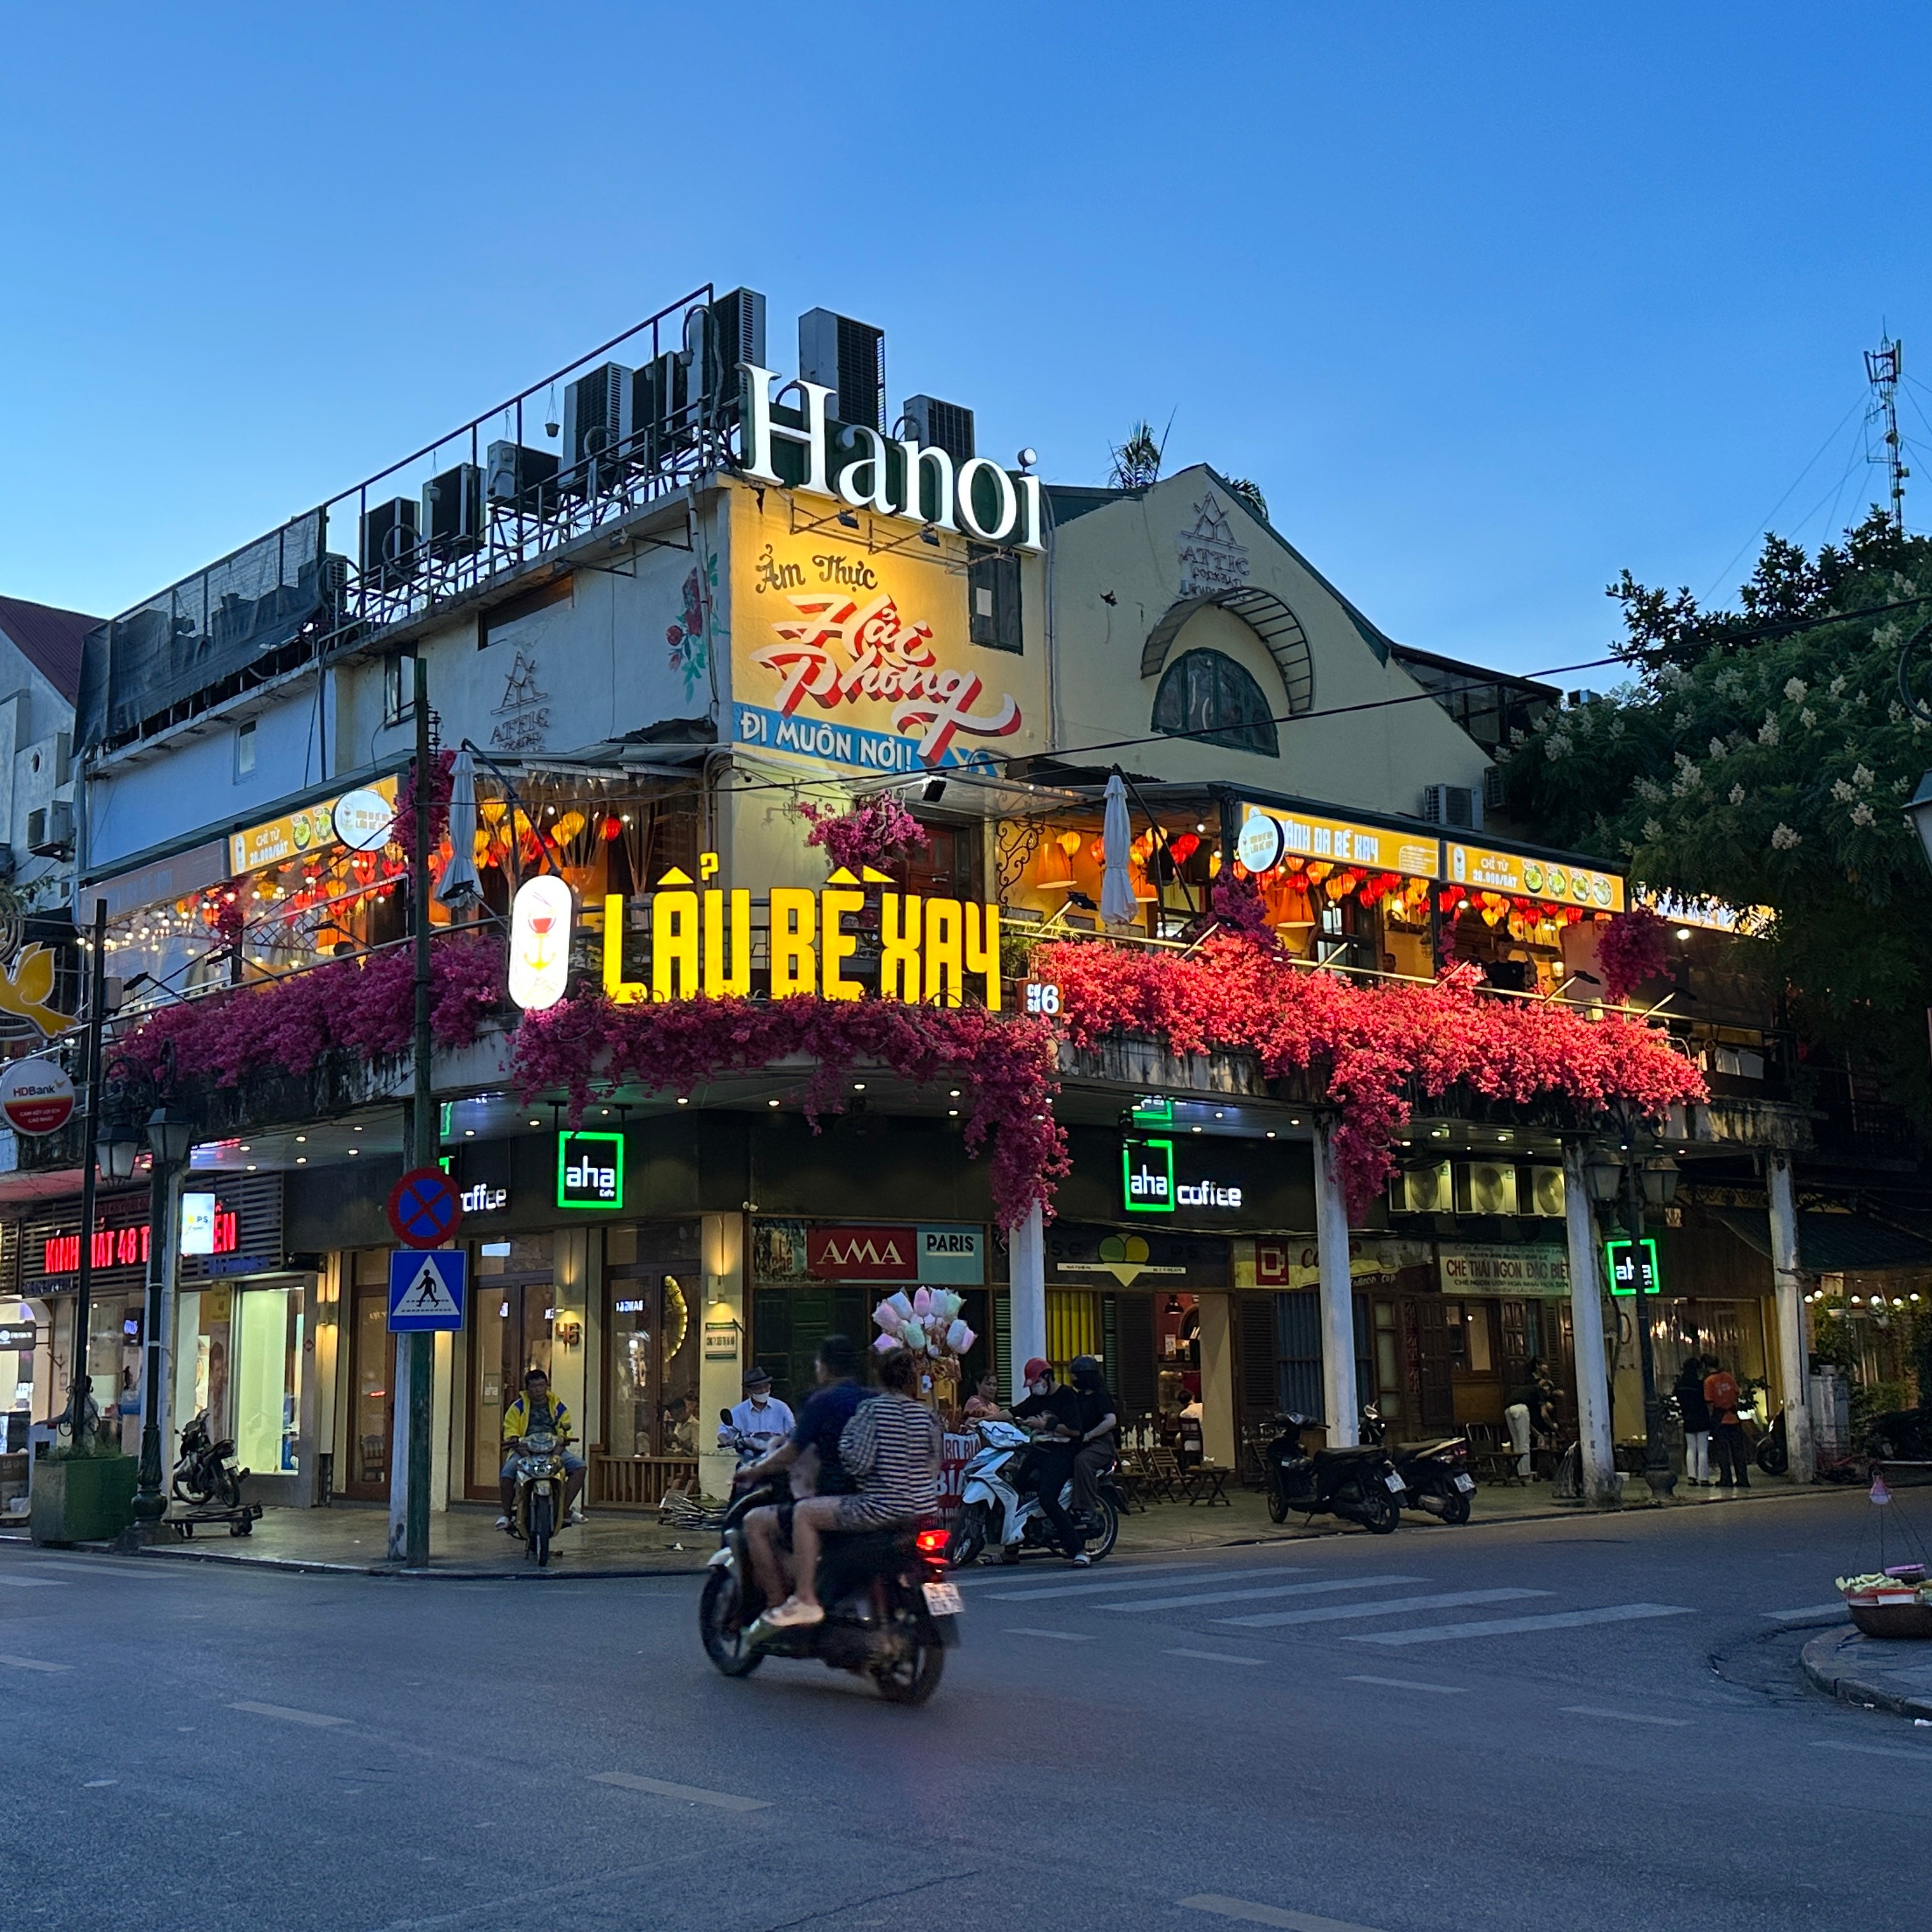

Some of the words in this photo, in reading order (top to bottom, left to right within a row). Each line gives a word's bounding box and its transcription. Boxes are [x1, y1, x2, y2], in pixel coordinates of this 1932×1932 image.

[734, 362, 1048, 553] Hanoi
[1179, 545, 1250, 576] ATTIC
[740, 710, 767, 742] ĐI
[775, 723, 852, 762] MUÔN
[859, 735, 912, 772] NƠI!
[1278, 818, 1310, 852] ÁNH
[602, 852, 750, 1005] LẨU
[880, 892, 1002, 1012] XAY
[1041, 985, 1059, 1014] 6
[13, 1085, 56, 1097] HDBank
[566, 1155, 615, 1188] aha
[1131, 1164, 1168, 1195] aha
[1176, 1180, 1241, 1207] coffee
[459, 1183, 507, 1213] offee
[45, 1229, 80, 1273] KÍNH
[118, 1227, 137, 1265] 48
[816, 1238, 906, 1265] AMA
[926, 1234, 974, 1252] PARIS
[1468, 1259, 1490, 1278] THÁI
[1492, 1261, 1522, 1278] NGON
